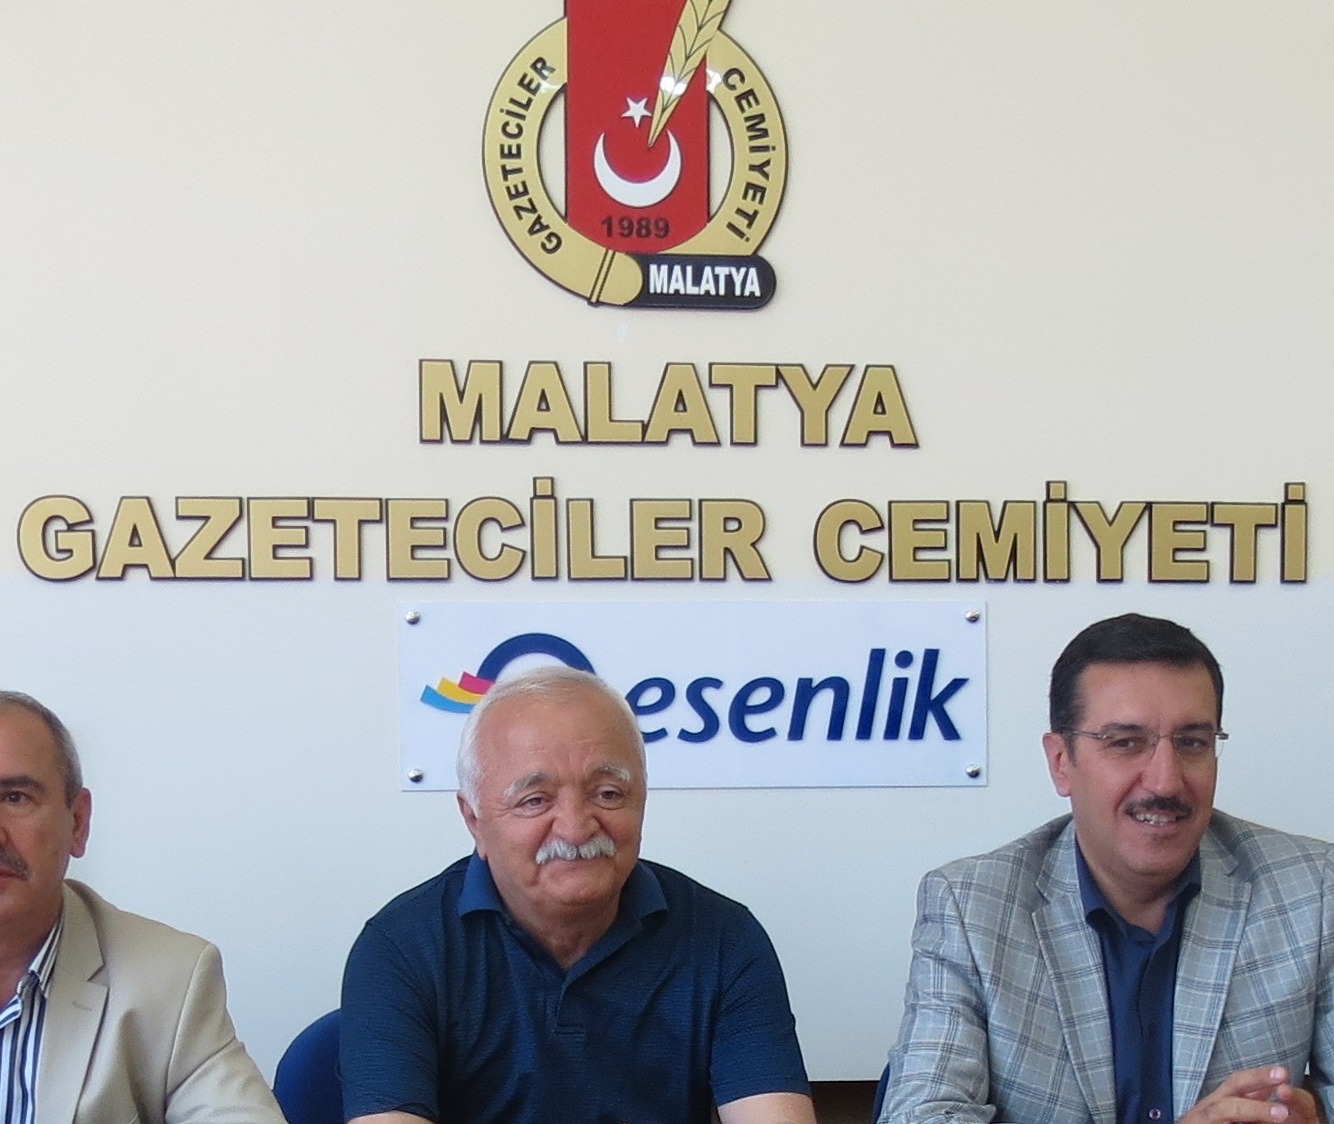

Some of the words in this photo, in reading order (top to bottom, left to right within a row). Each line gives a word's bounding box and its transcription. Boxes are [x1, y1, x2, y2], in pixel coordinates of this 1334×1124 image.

[499, 55, 563, 255] GAZETECİLER
[721, 66, 778, 244] CEMİYETİ
[601, 215, 670, 239] 1989
[648, 263, 762, 298] MALATYA
[417, 357, 919, 449] MALATYA
[15, 474, 771, 582] GAZETECİLER
[812, 478, 1310, 586] CEMİYETİ
[625, 647, 971, 744] esenlik
